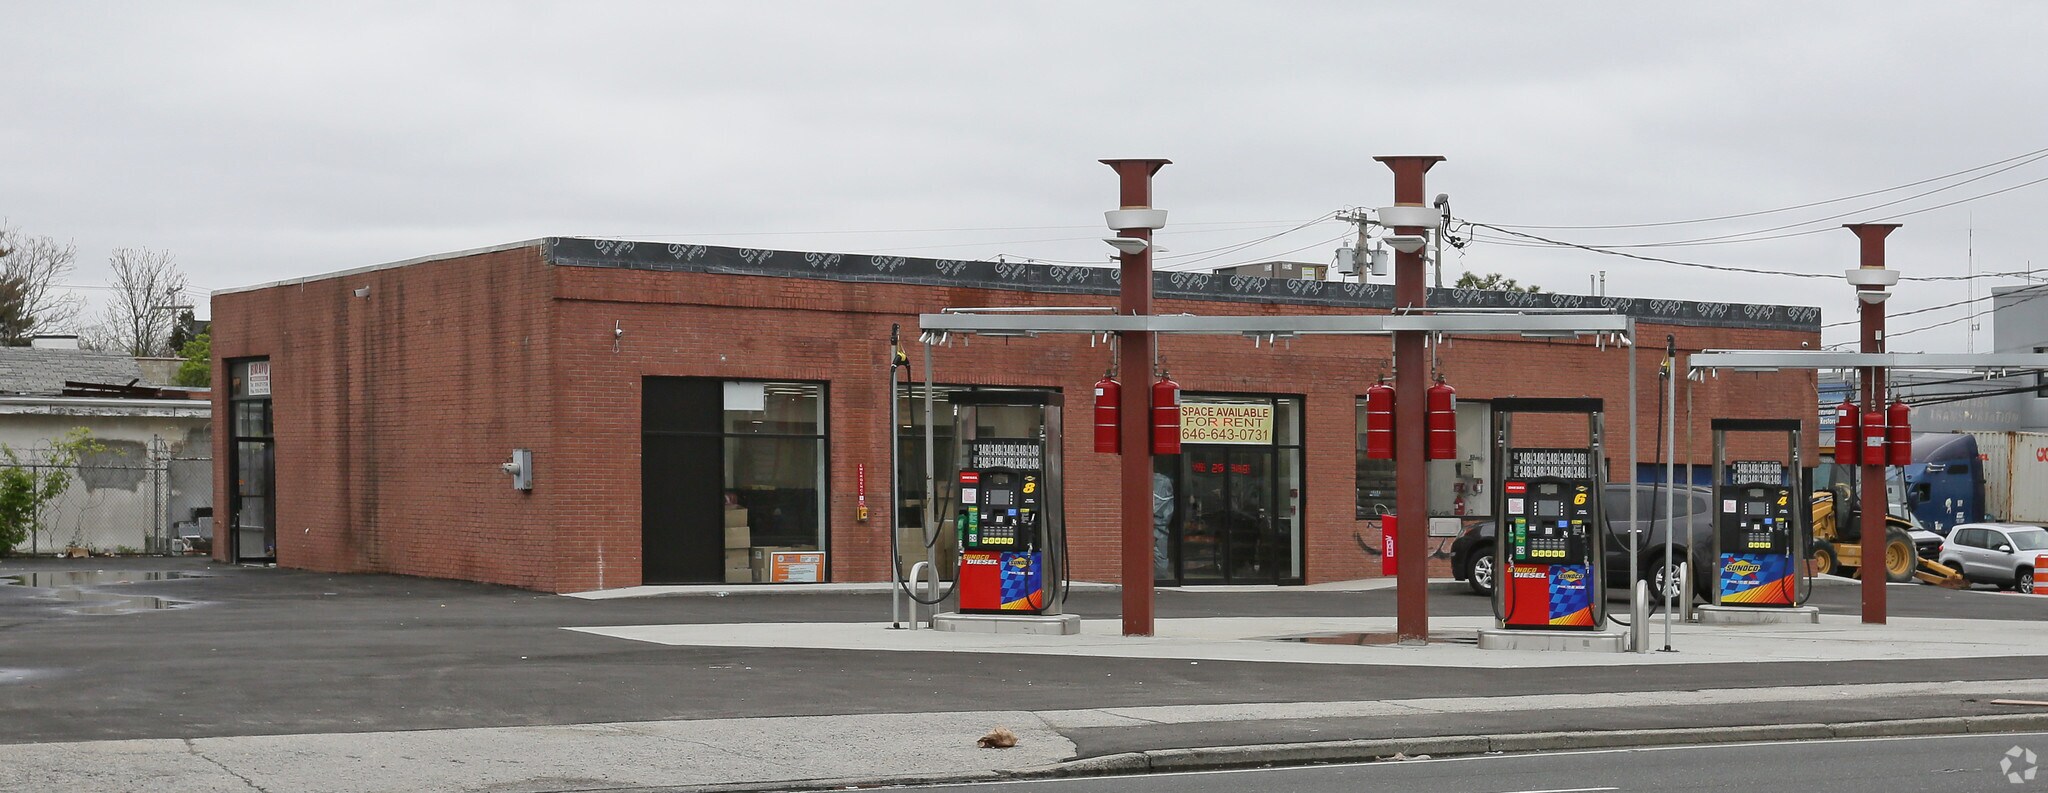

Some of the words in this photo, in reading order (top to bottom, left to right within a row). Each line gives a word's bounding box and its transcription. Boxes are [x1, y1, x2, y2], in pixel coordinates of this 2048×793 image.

[1182, 407, 1213, 416] SPACE
[1216, 408, 1268, 417] AVAILABLE
[1186, 417, 1218, 426] FOR
[1223, 418, 1264, 427] RENT
[1182, 428, 1268, 441] 646-643-0731
[1022, 482, 1036, 493] 8
[1573, 493, 1587, 505] 6
[1777, 496, 1787, 505] 4
[1726, 564, 1759, 572] SUNOCO
